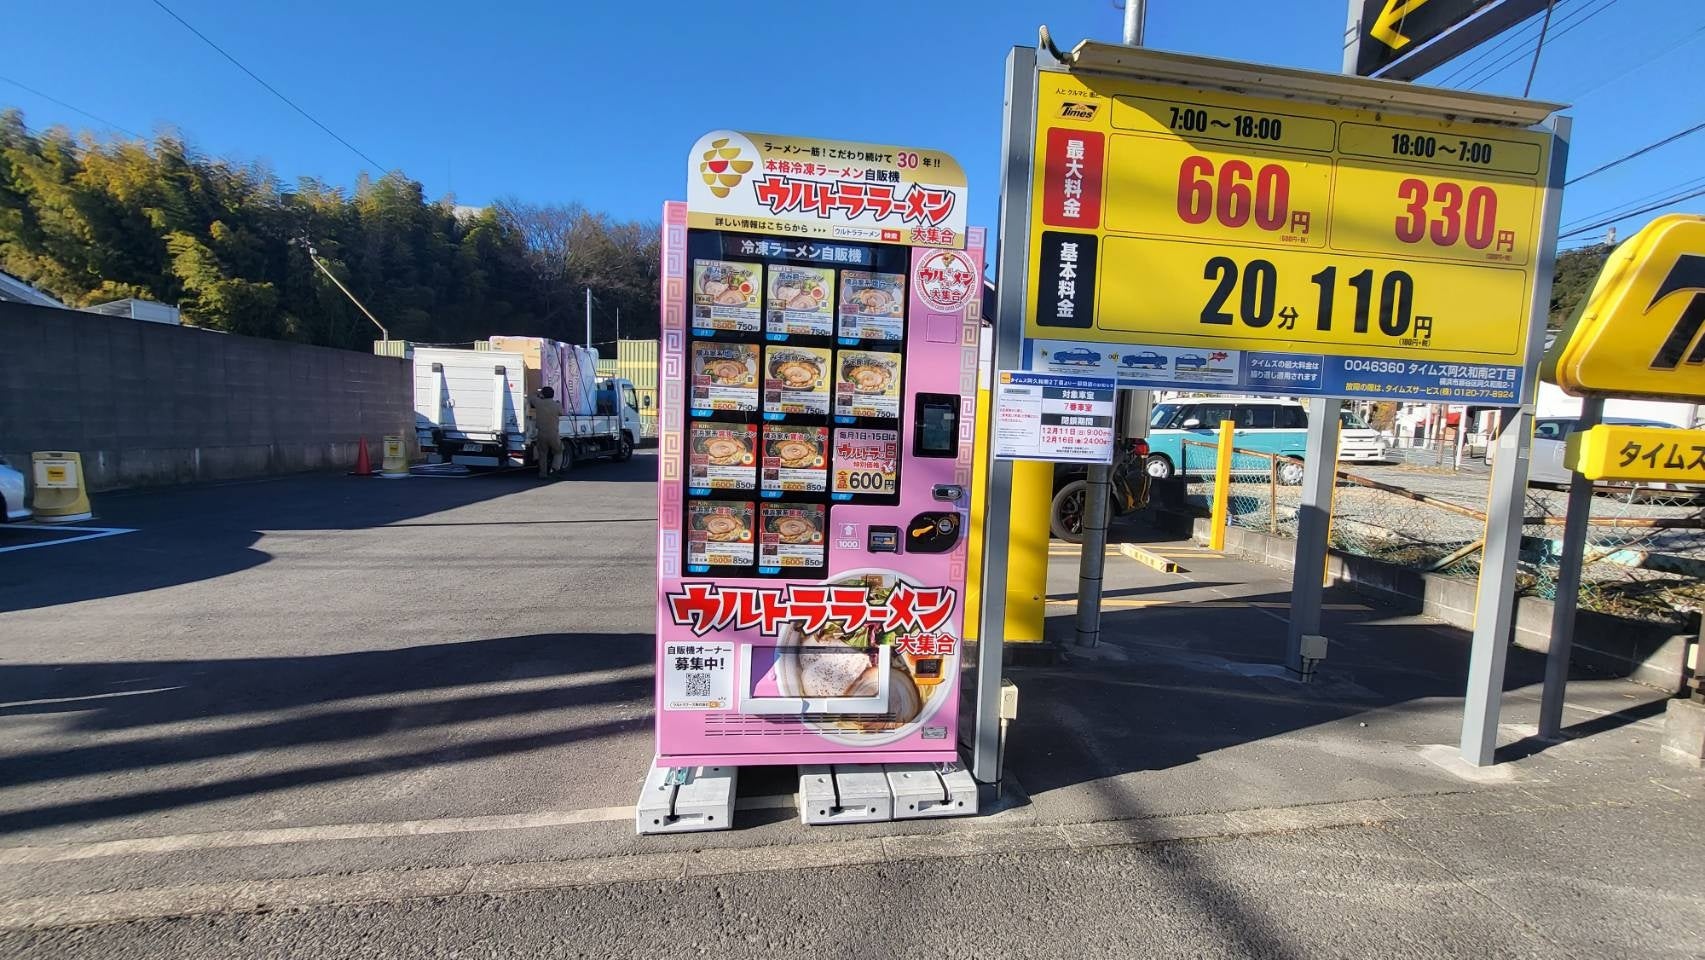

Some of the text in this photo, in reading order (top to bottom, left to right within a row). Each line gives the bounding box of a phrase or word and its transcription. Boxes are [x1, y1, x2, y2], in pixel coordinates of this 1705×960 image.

[1061, 102, 1097, 118] Times
[766, 160, 900, 183] 本格冷凍ラーメン自販機
[1062, 139, 1085, 218] 最大料金
[753, 174, 955, 227] ウルトララーメン
[1177, 155, 1310, 235] 660円
[1395, 178, 1514, 252] 330円
[715, 217, 808, 233] 詳しい情報はこちらから
[834, 228, 881, 239] ウルトララーメン
[911, 226, 956, 244] 大集合
[741, 239, 862, 263] 冷凍ラーメン自販機
[1057, 242, 1079, 318] 基本料金
[931, 289, 961, 301] 大集合
[1200, 256, 1432, 339] 20分 110円
[1344, 360, 1516, 381] 0046360 タイムズ阿久和南2丁目
[666, 579, 957, 636] ウルトララーメン
[667, 645, 732, 655] 自販機オーナー
[895, 632, 958, 655] 大集合
